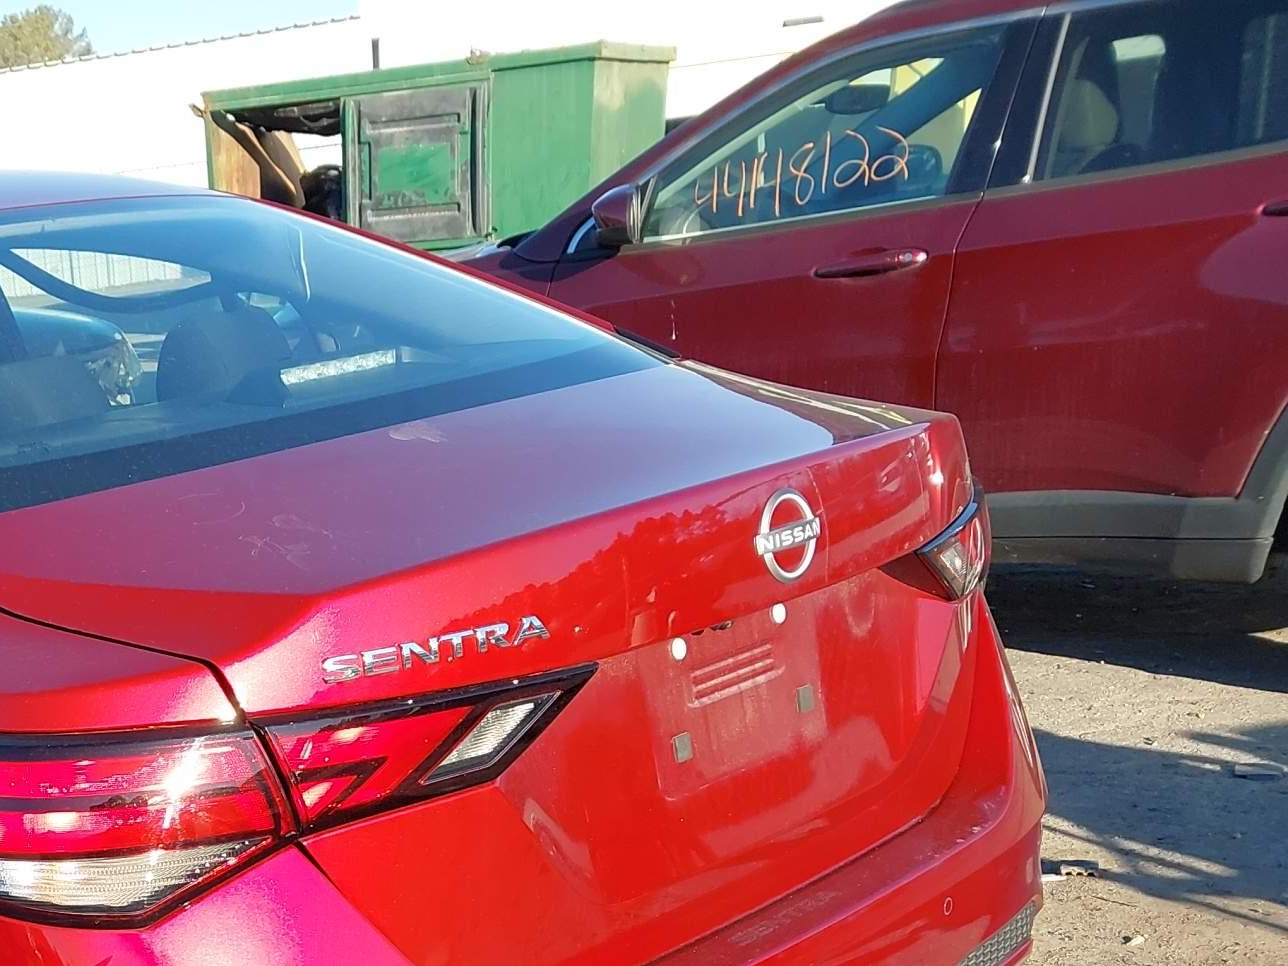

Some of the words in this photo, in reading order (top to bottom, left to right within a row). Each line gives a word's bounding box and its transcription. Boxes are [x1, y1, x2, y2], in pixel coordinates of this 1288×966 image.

[694, 126, 909, 218] 44148122
[757, 518, 820, 556] NISSAN
[321, 614, 550, 684] SENTRA
